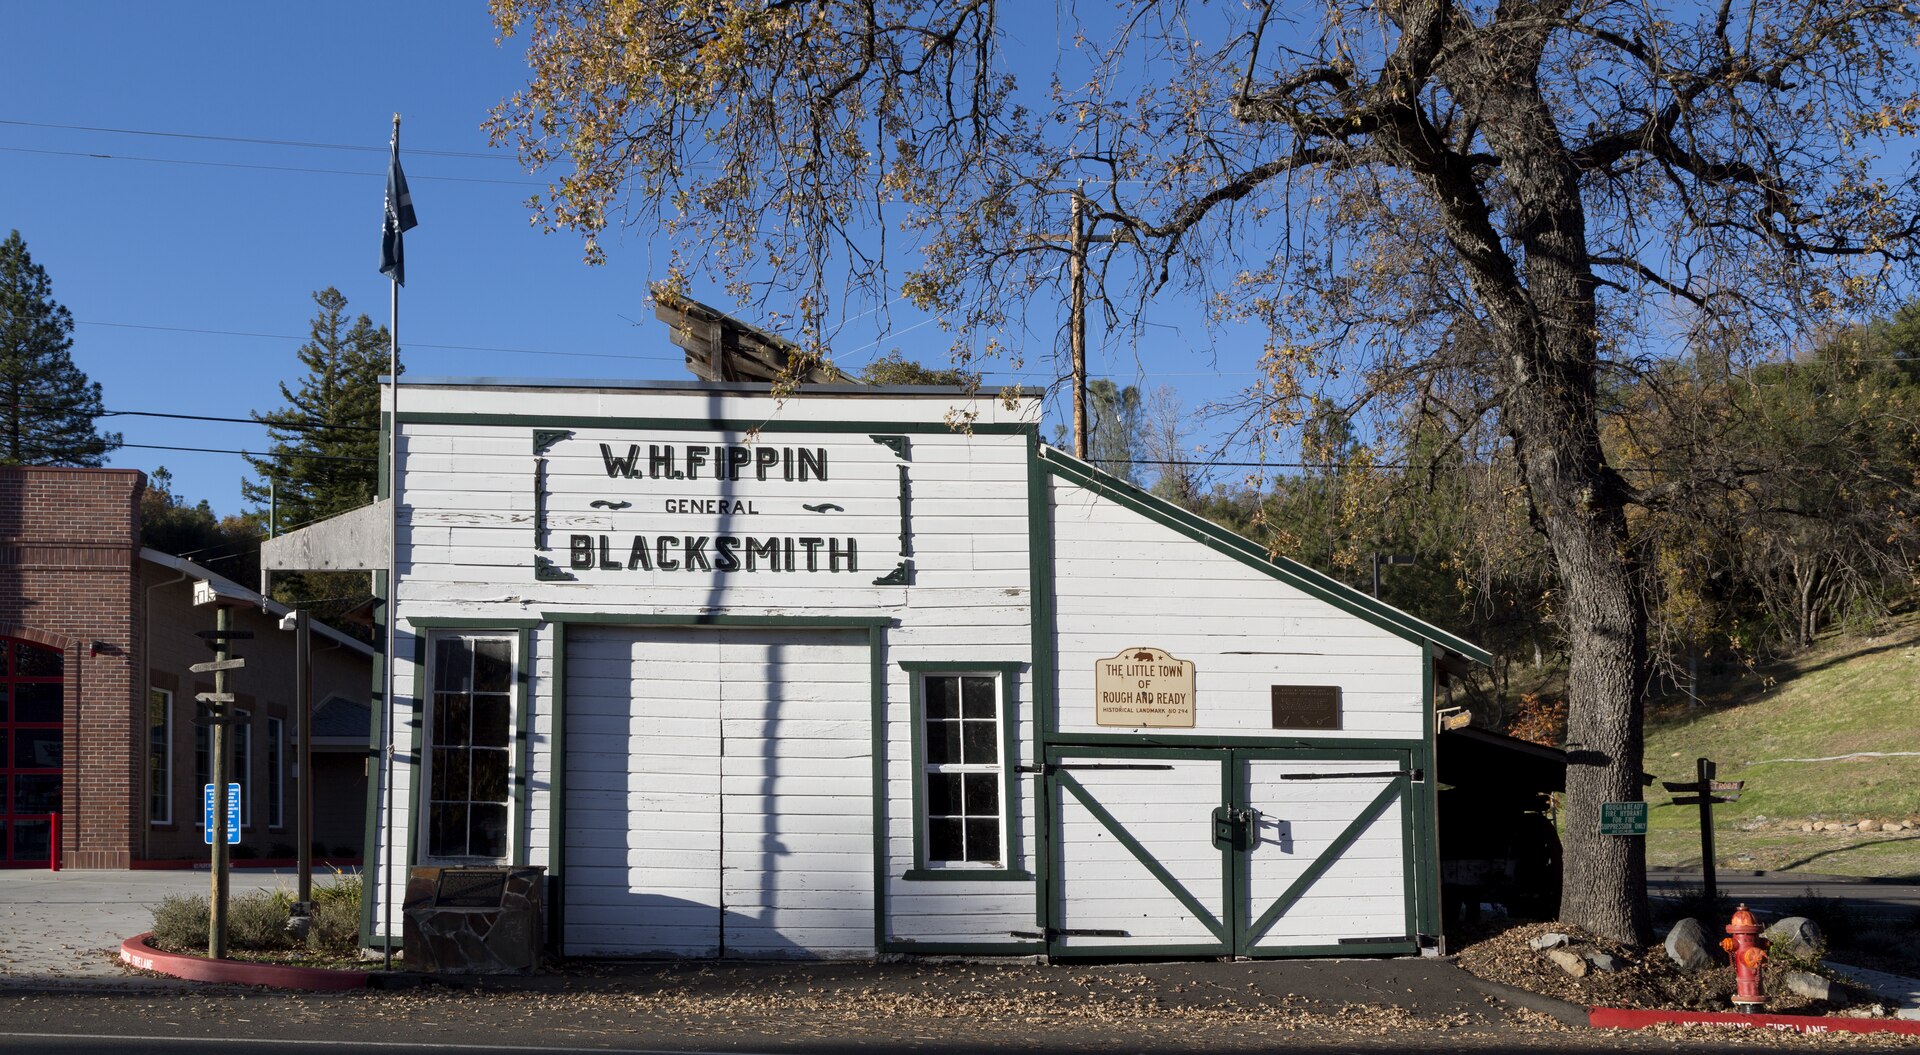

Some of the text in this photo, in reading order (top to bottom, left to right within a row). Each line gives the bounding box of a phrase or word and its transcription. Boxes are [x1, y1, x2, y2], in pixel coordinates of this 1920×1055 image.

[664, 498, 759, 516] GENERAL
[569, 533, 858, 573] BLACKSMITH
[1106, 664, 1183, 677] THE LITTLE TOWN
[1138, 679, 1151, 689] OF
[1103, 691, 1186, 705] ROUGH AND READY
